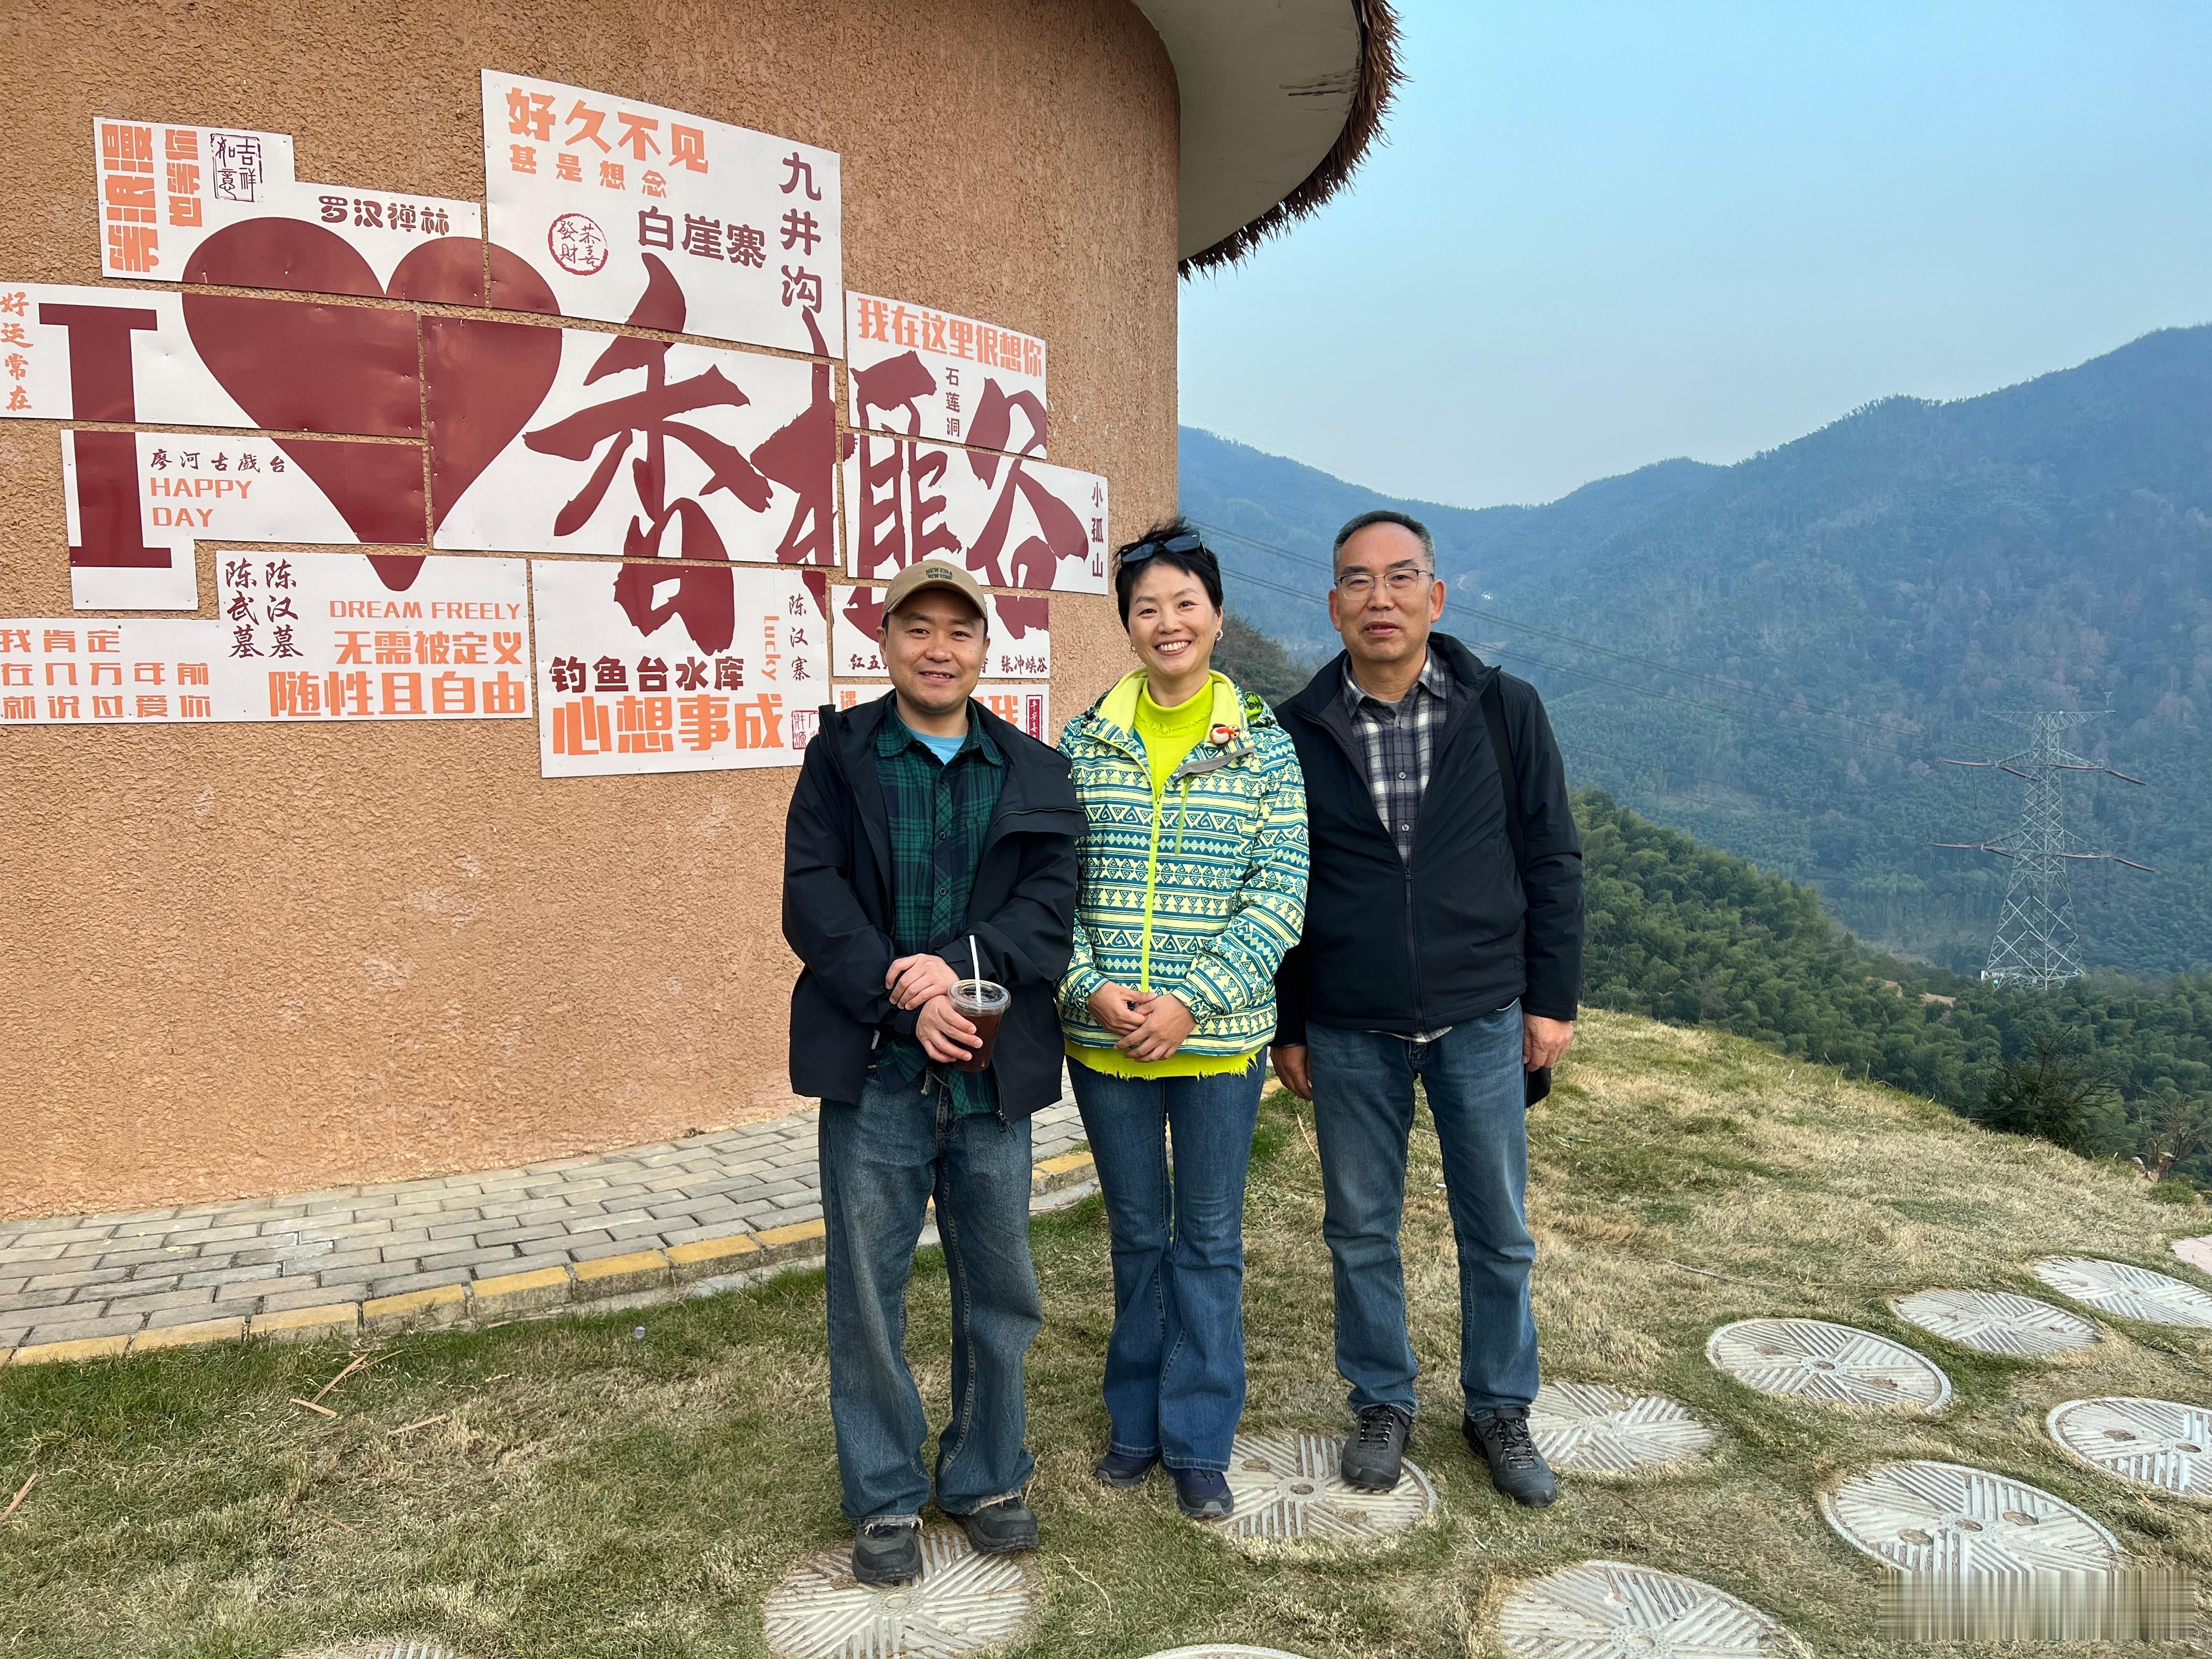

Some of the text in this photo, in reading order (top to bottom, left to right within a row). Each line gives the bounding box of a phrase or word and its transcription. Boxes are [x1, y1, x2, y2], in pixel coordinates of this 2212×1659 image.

[506, 87, 709, 174] 好久不见
[510, 143, 667, 198] 甚是想念
[319, 195, 449, 235] 罗汉禅林
[637, 205, 767, 269] 白崖寨
[778, 151, 822, 314] 九井沟
[0, 291, 33, 411] 好运常在
[857, 297, 1042, 377] 我在这里很想你
[945, 366, 960, 437] 石莲洞
[38, 302, 172, 568] I
[150, 477, 252, 499] HAPPY
[153, 507, 213, 527] DAY
[1091, 481, 1104, 578] 小孤山
[940, 567, 953, 577] ERA
[225, 557, 264, 659] 陈武墓
[266, 558, 304, 659] 陈汉墓
[330, 601, 521, 619] DREAM FREELY
[0, 629, 120, 653] 我肯定
[334, 630, 523, 664] 无需被定义
[761, 616, 781, 681] Lucky
[789, 593, 811, 681] 陈汉寨
[850, 653, 888, 670] 红五
[1001, 654, 1047, 675] 张冲峡谷
[1, 662, 209, 686] 在几万年前
[268, 671, 526, 717] 随性且自由
[549, 656, 744, 693] 钓鱼台水库
[3, 695, 211, 719] 就说过爱你
[552, 693, 785, 756] 心想事成
